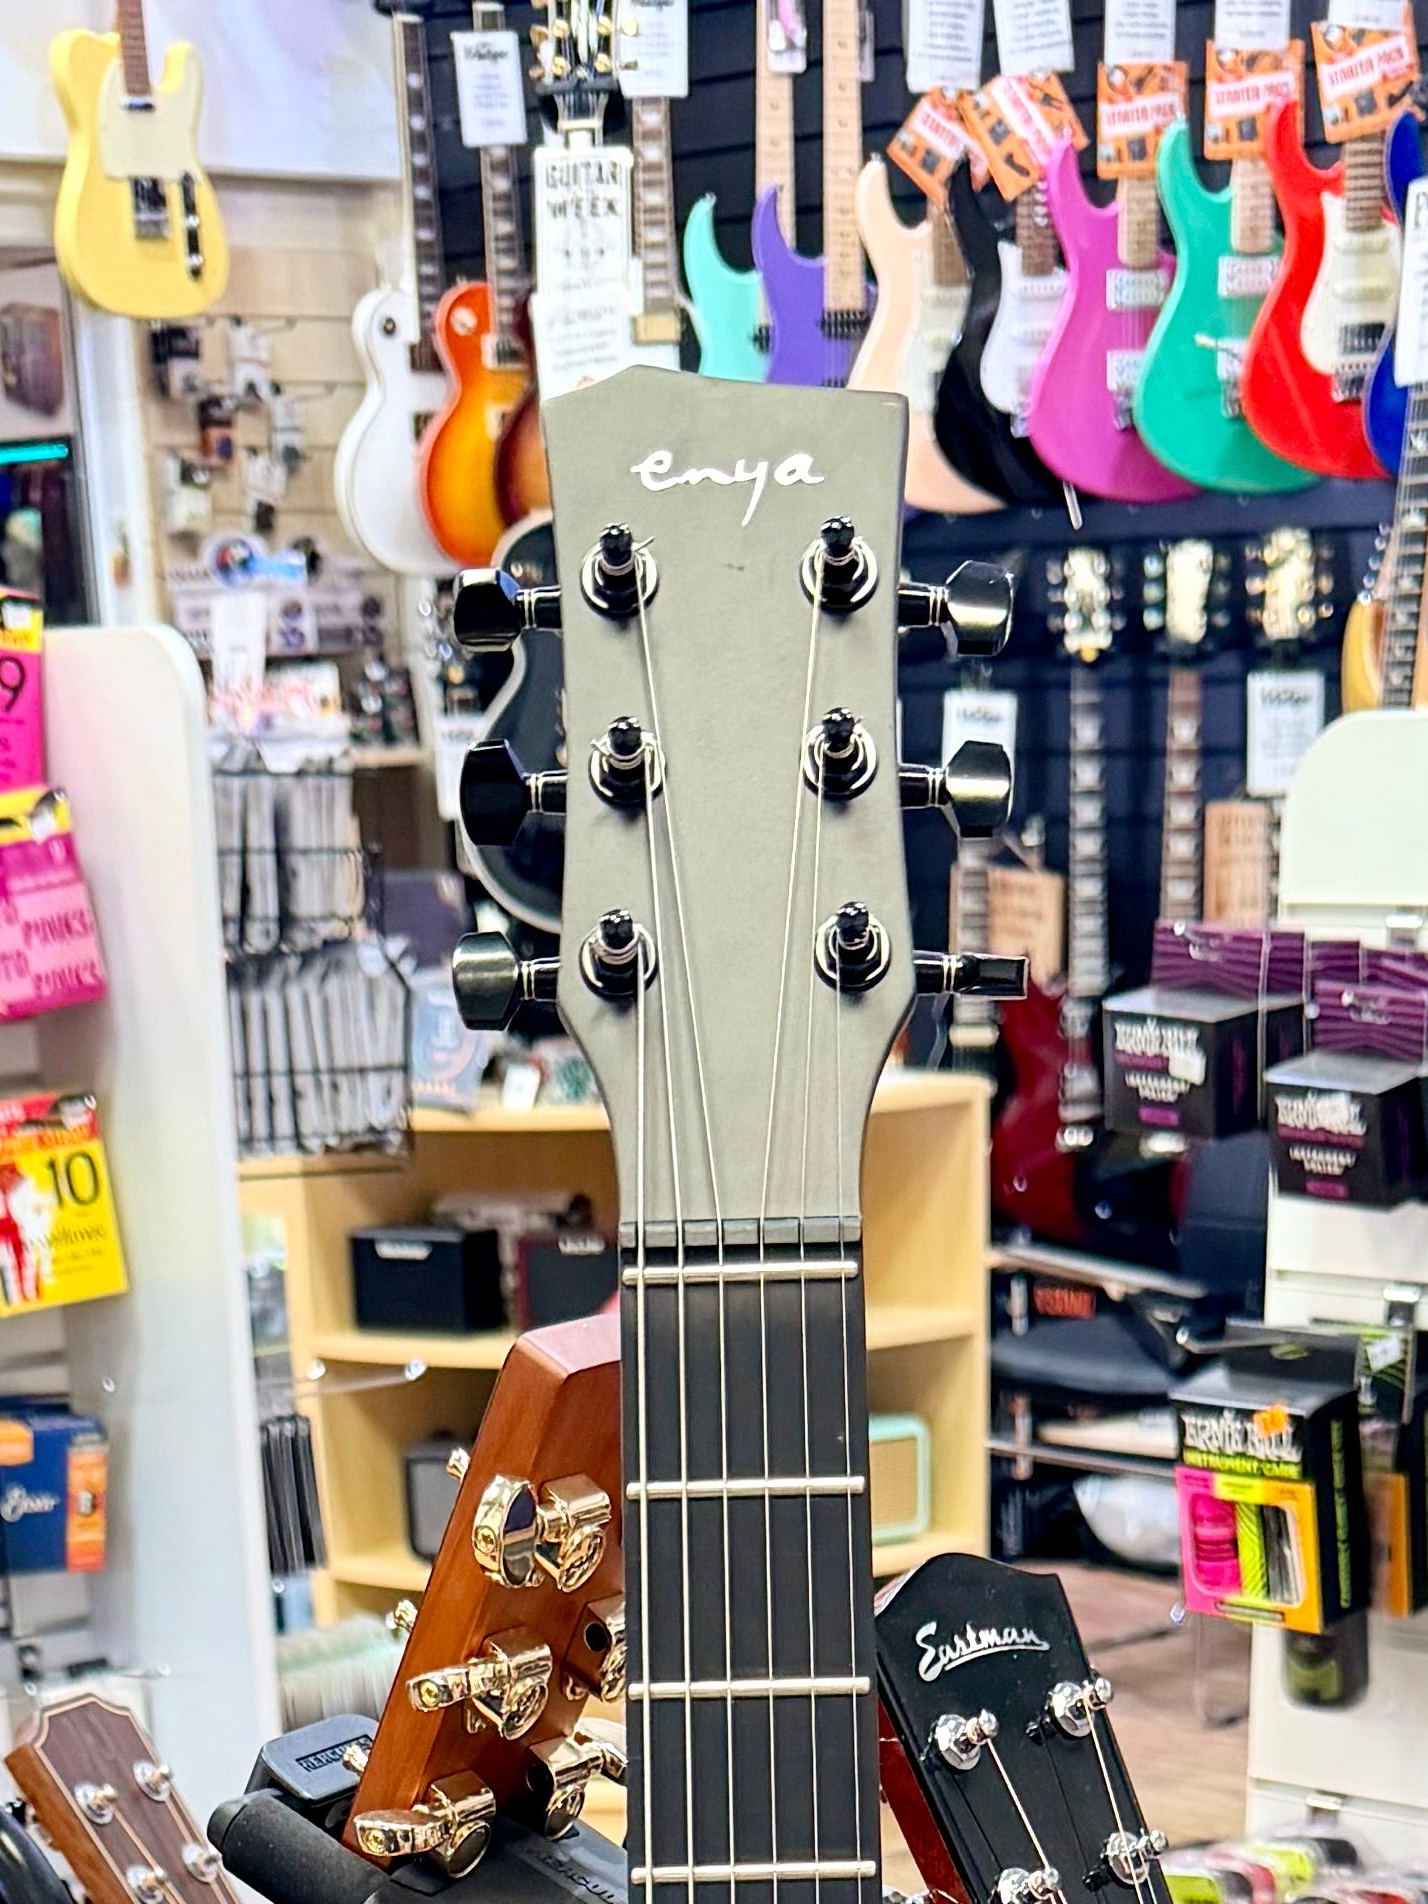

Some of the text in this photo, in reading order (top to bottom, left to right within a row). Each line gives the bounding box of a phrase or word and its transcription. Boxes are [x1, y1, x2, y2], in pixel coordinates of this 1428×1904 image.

[545, 159, 621, 188] GUITAR
[546, 197, 620, 220] WEEK
[630, 448, 825, 526] enya
[45, 1149, 101, 1208] 10
[1180, 1408, 1242, 1452] ERNIE
[915, 1620, 1051, 1683] Eastman
[297, 1734, 372, 1773] HERCUS
